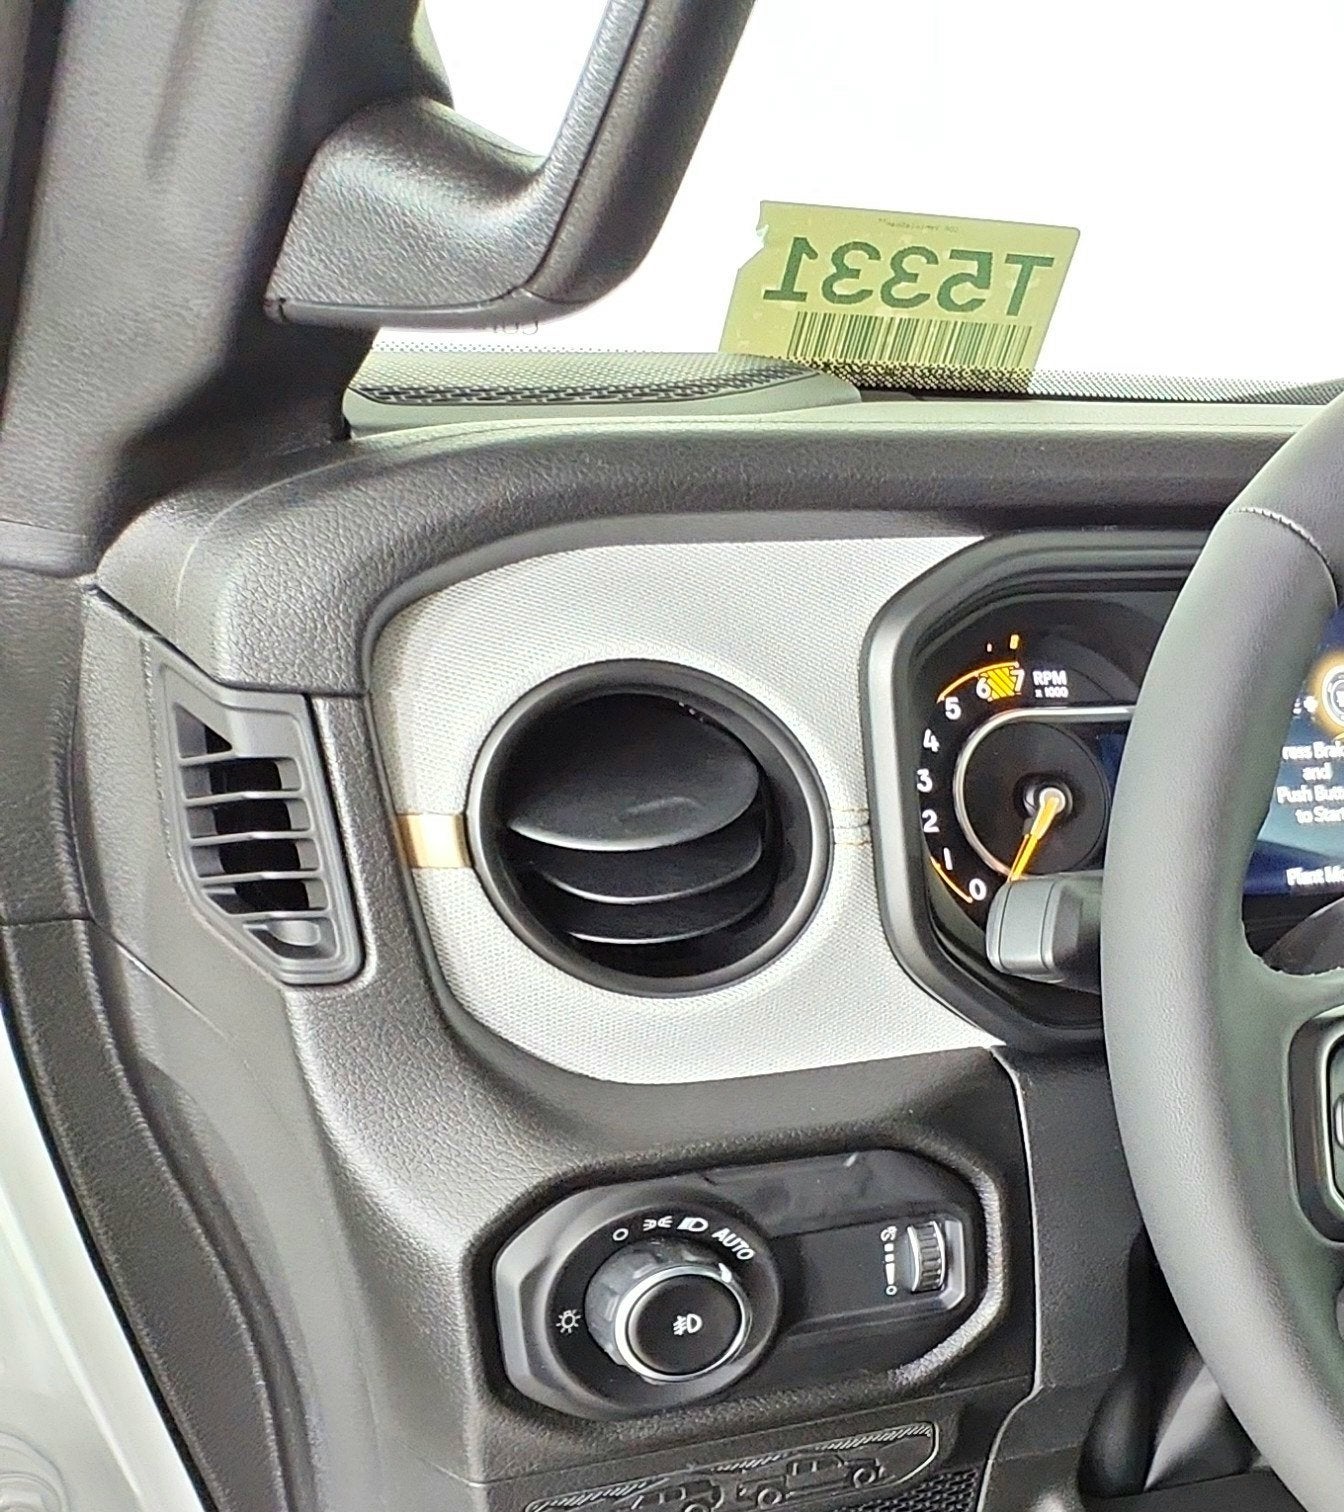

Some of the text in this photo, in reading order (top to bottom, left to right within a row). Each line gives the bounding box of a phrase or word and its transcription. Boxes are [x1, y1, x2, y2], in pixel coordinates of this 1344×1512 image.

[976, 677, 991, 699] 6
[1010, 669, 1025, 694] 7
[1033, 670, 1067, 686] RPM
[1044, 686, 1068, 698] 1000
[945, 697, 961, 720] 5
[923, 729, 939, 752] 4
[1282, 745, 1312, 760] ress
[917, 768, 933, 793] 3
[1302, 763, 1333, 781] and
[1276, 785, 1312, 804] Push
[922, 809, 939, 833] 2
[1295, 808, 1312, 824] to
[943, 848, 953, 871] 1
[969, 878, 987, 901] 0
[712, 1227, 755, 1260] AUTO
